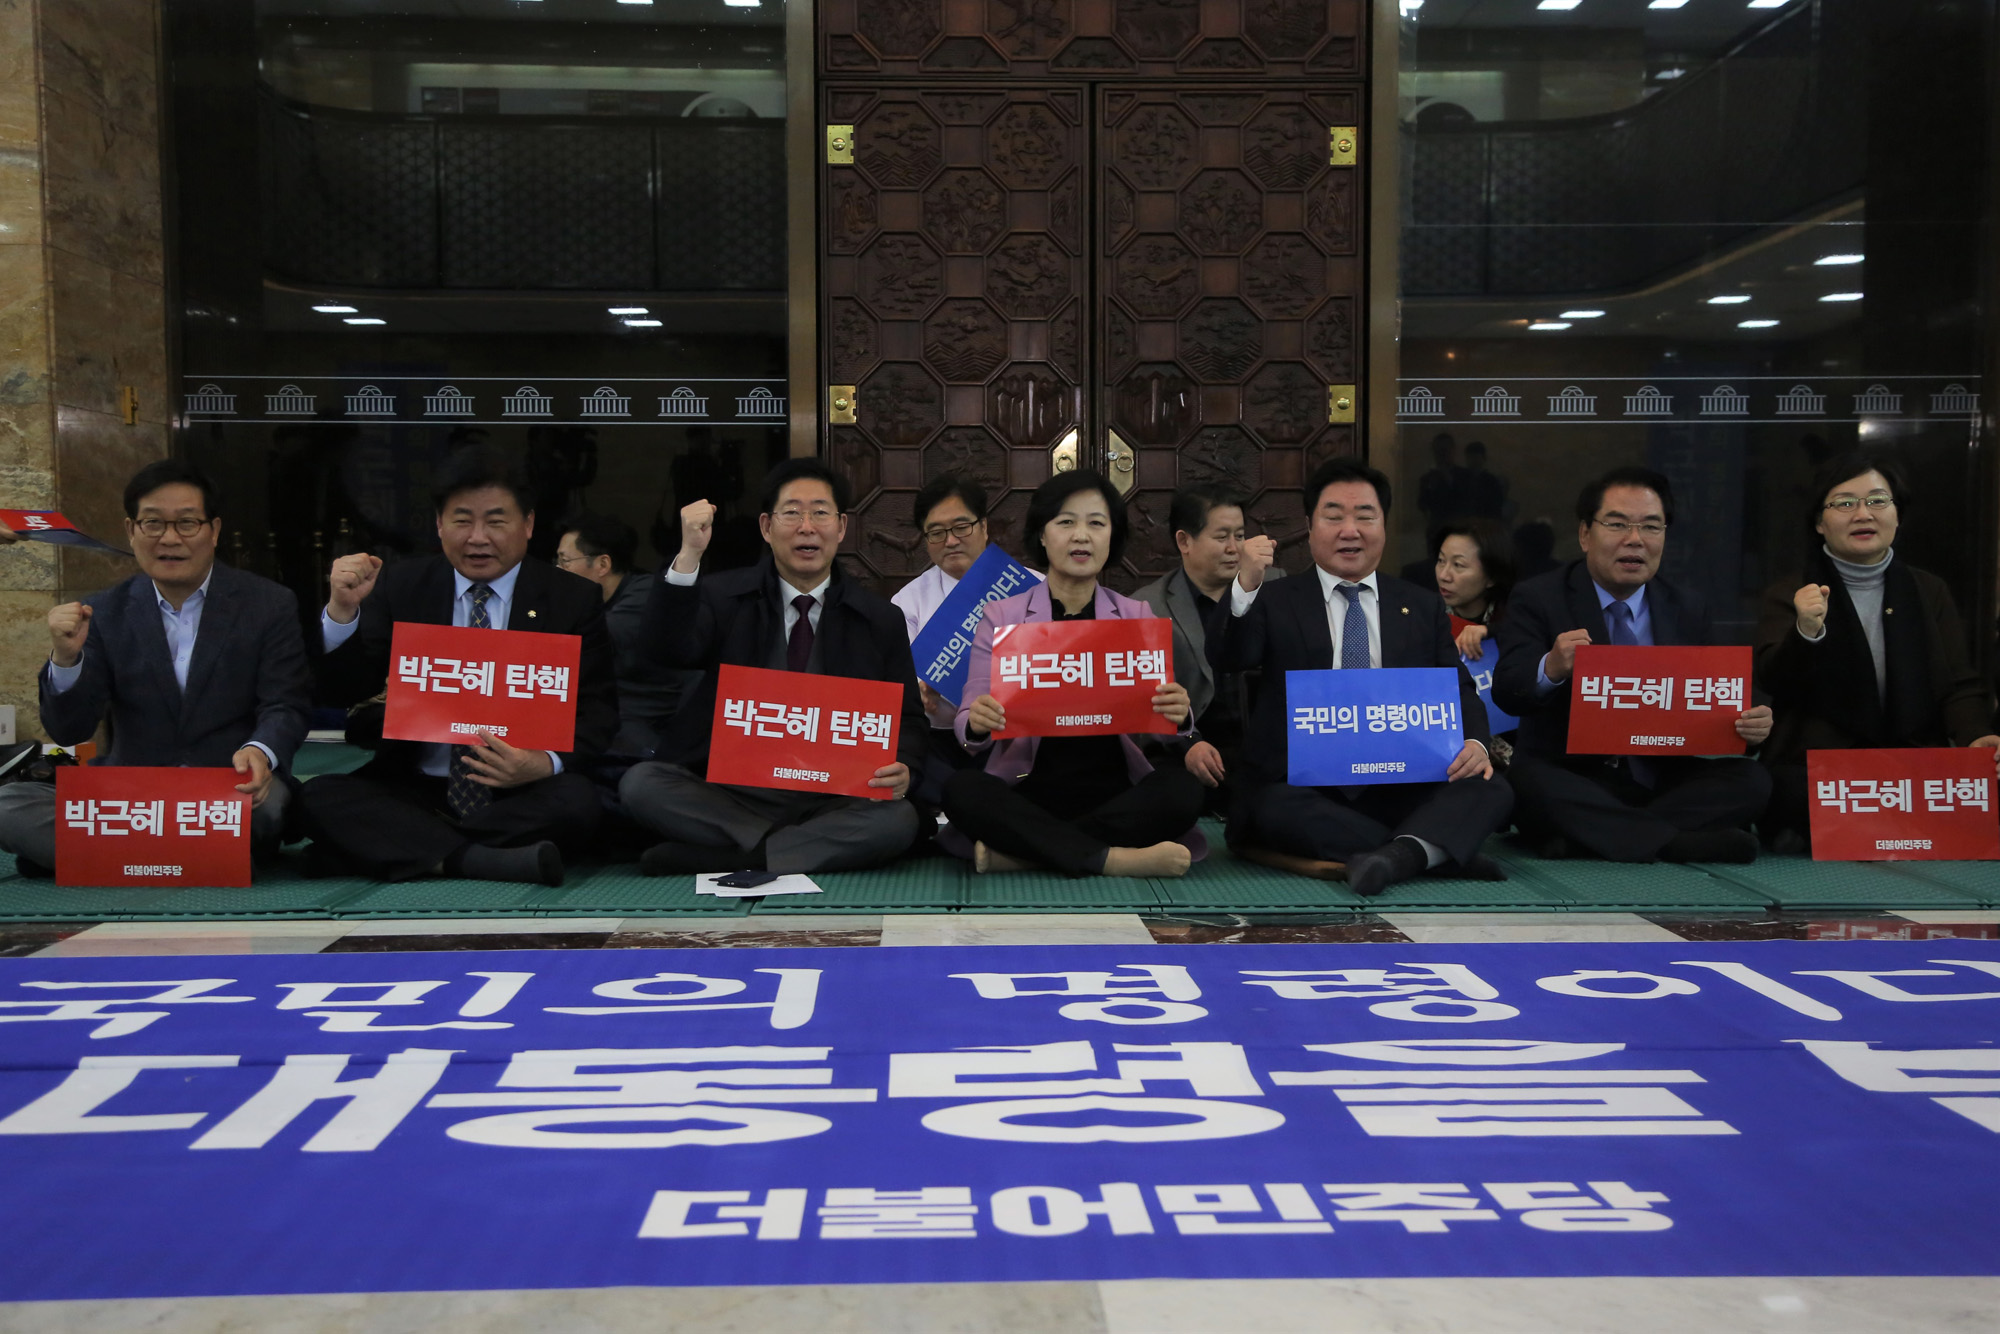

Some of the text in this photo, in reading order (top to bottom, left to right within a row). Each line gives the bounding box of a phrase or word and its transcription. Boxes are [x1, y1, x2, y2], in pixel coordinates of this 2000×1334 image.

[925, 631, 973, 683] 국민의
[999, 649, 1167, 690] 박근혜 탄핵
[398, 655, 570, 703] 박근혜 탄핵
[1581, 675, 1744, 712] 박근혜 탄핵
[723, 698, 892, 750] 박근혜 탄핵
[1055, 713, 1113, 727] 더불어민주당
[1293, 702, 1458, 735] 국민의 명령이다!
[1630, 734, 1686, 747] 더불어민주당
[773, 766, 831, 784] 더불어민주당
[1351, 760, 1406, 775] 더불어민주당
[1817, 777, 1989, 814] 박근혜 탄핵
[65, 799, 243, 837] 박근혜 탄핵
[1875, 838, 1933, 851] 더불어민주당
[124, 864, 183, 877] 더불어민주당
[0, 968, 824, 1039] 국민의
[0, 1039, 1742, 1153] 대통령을
[637, 1181, 1675, 1241] 더불어민주당
